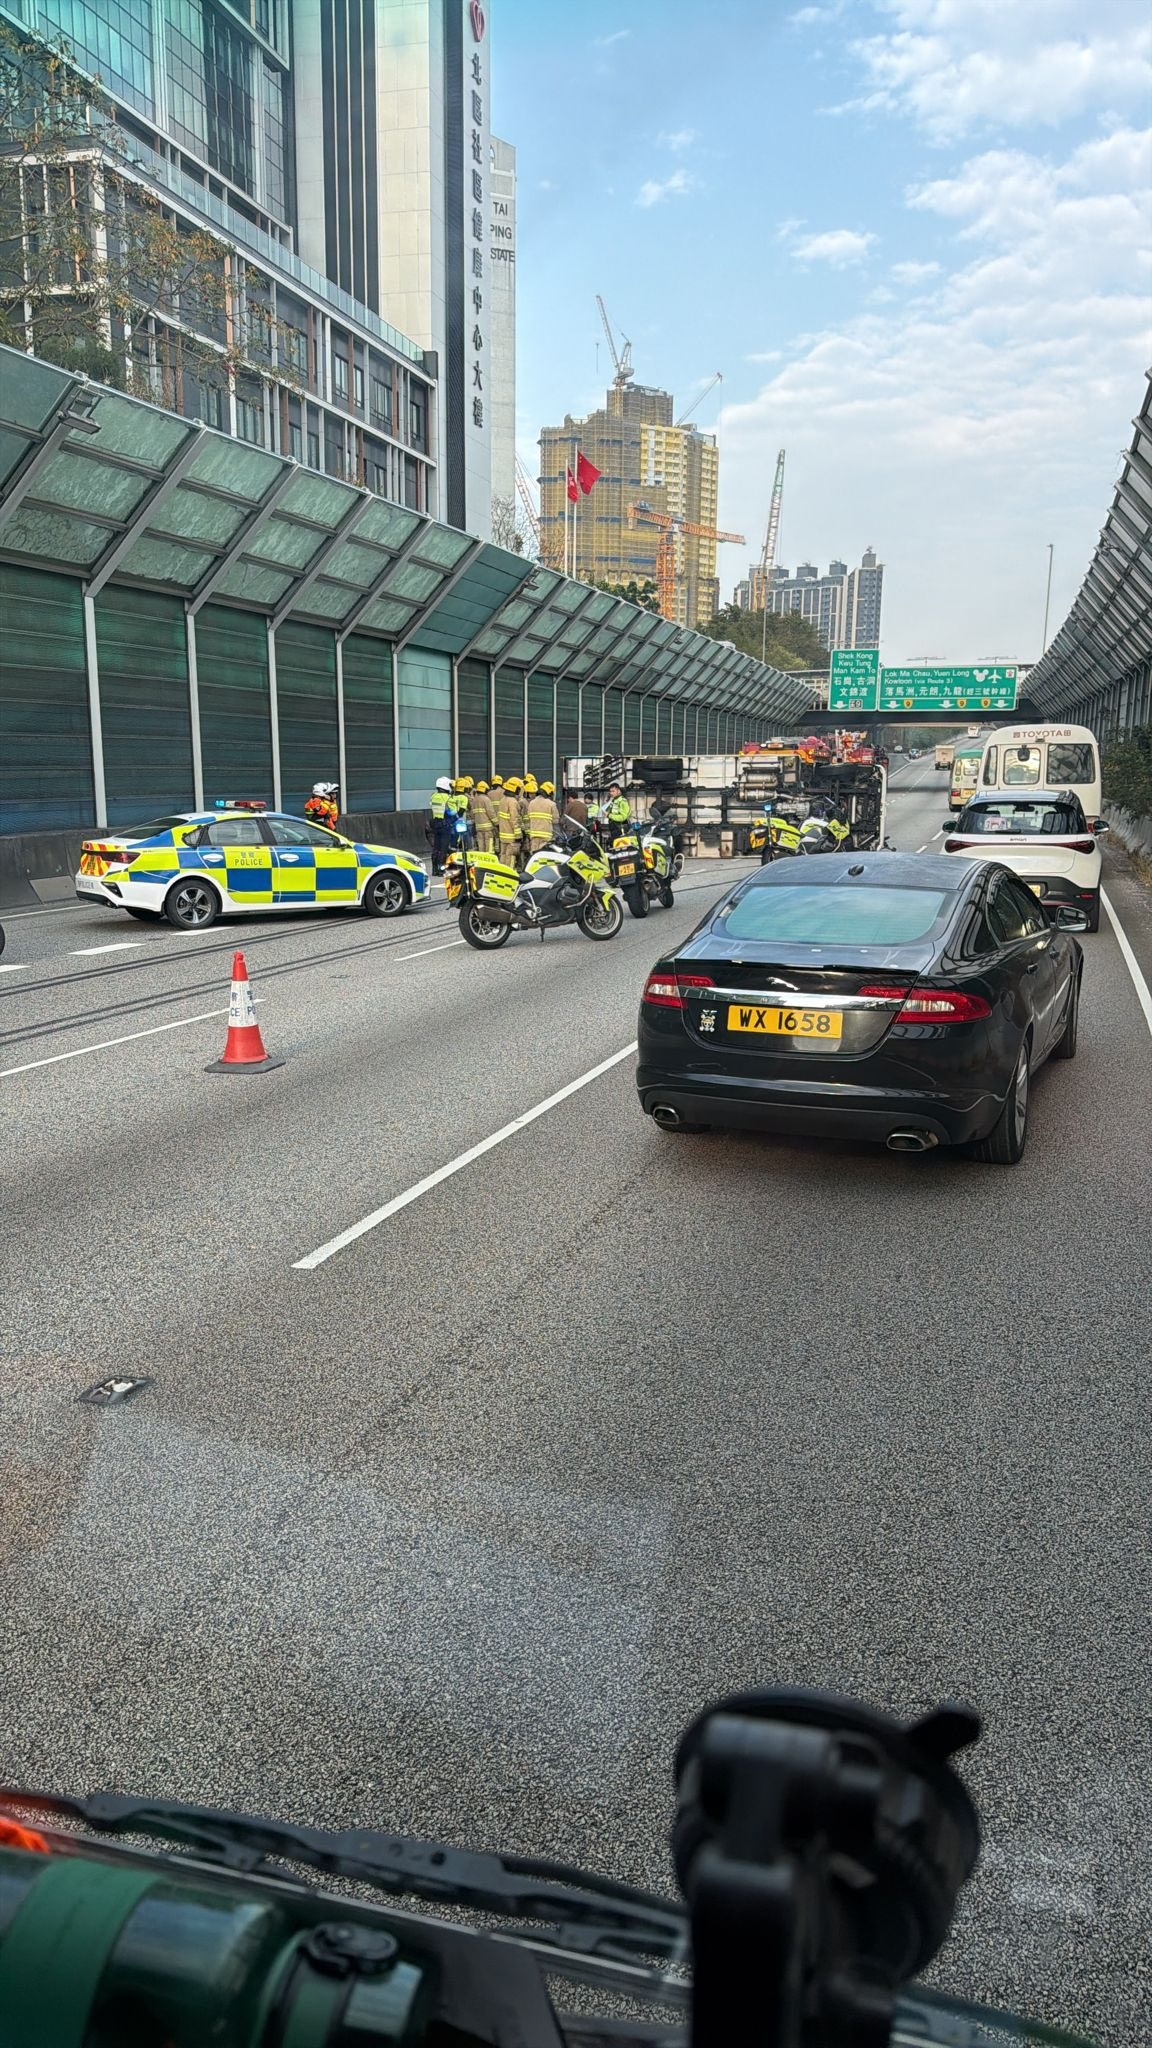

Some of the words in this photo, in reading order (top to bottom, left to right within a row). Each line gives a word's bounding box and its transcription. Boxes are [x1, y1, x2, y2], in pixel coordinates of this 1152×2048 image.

[492, 202, 508, 216] TAI
[856, 652, 873, 660] Kong
[933, 669, 951, 677] Yuen
[953, 669, 970, 677] Long
[1022, 730, 1063, 738] TOYOTA
[234, 858, 263, 866] POLICE
[739, 1008, 767, 1029] WX
[777, 1011, 831, 1033] 1658
